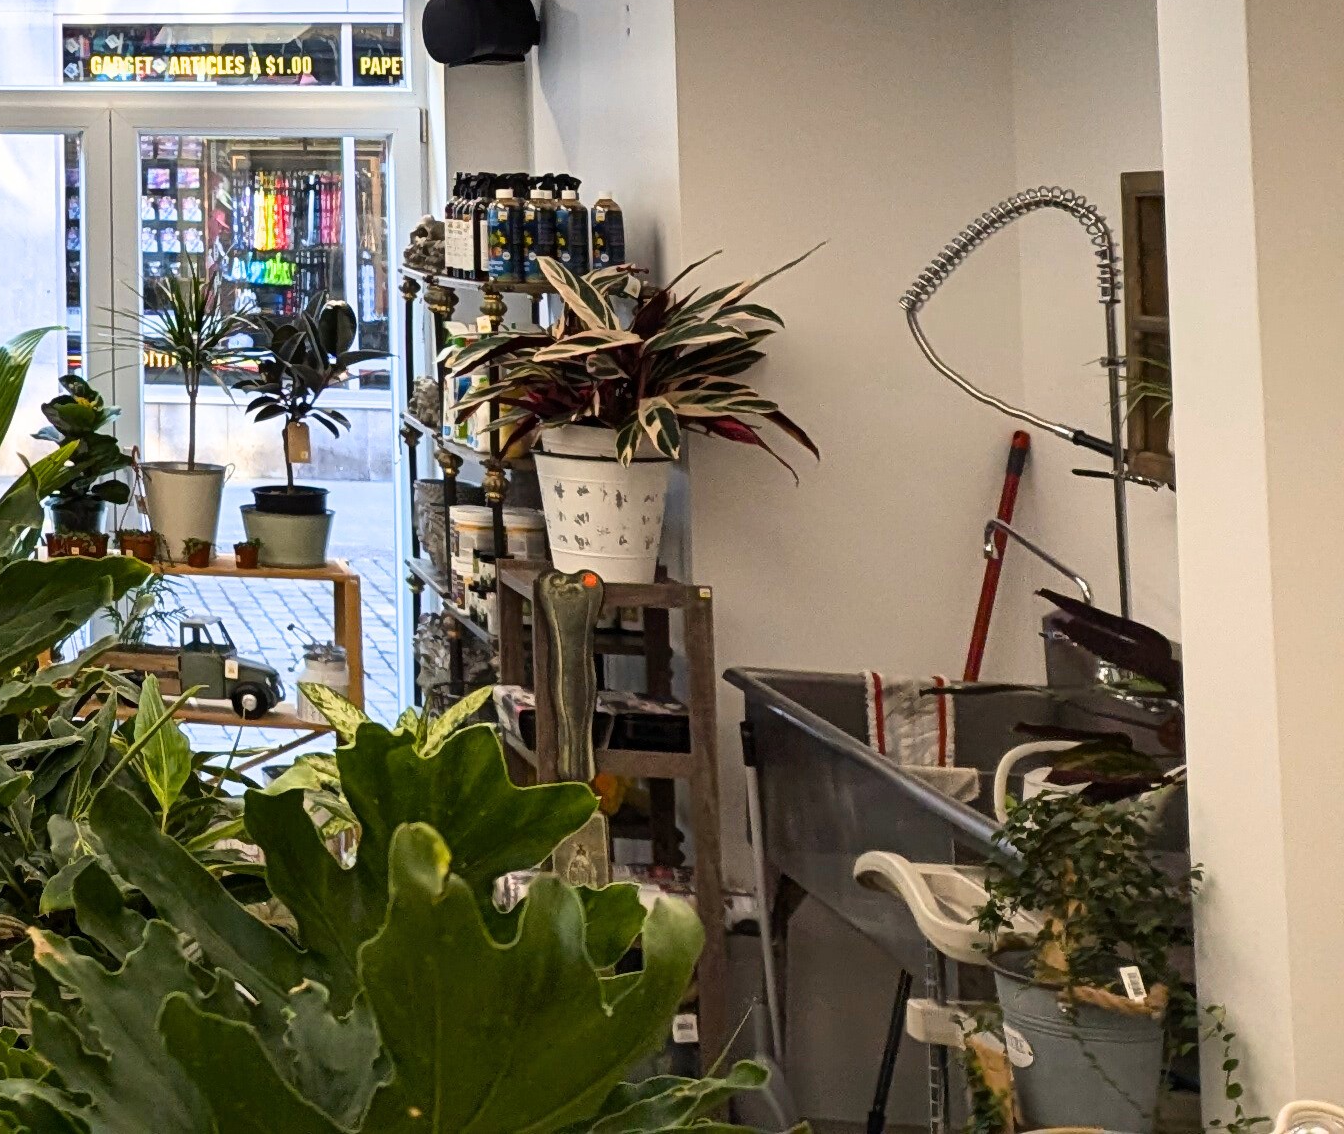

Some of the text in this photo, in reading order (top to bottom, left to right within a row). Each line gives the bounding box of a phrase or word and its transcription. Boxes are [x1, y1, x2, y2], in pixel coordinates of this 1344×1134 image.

[90, 55, 154, 75] GADGET
[168, 55, 245, 75] ARTICLES
[265, 54, 312, 76] $1.00
